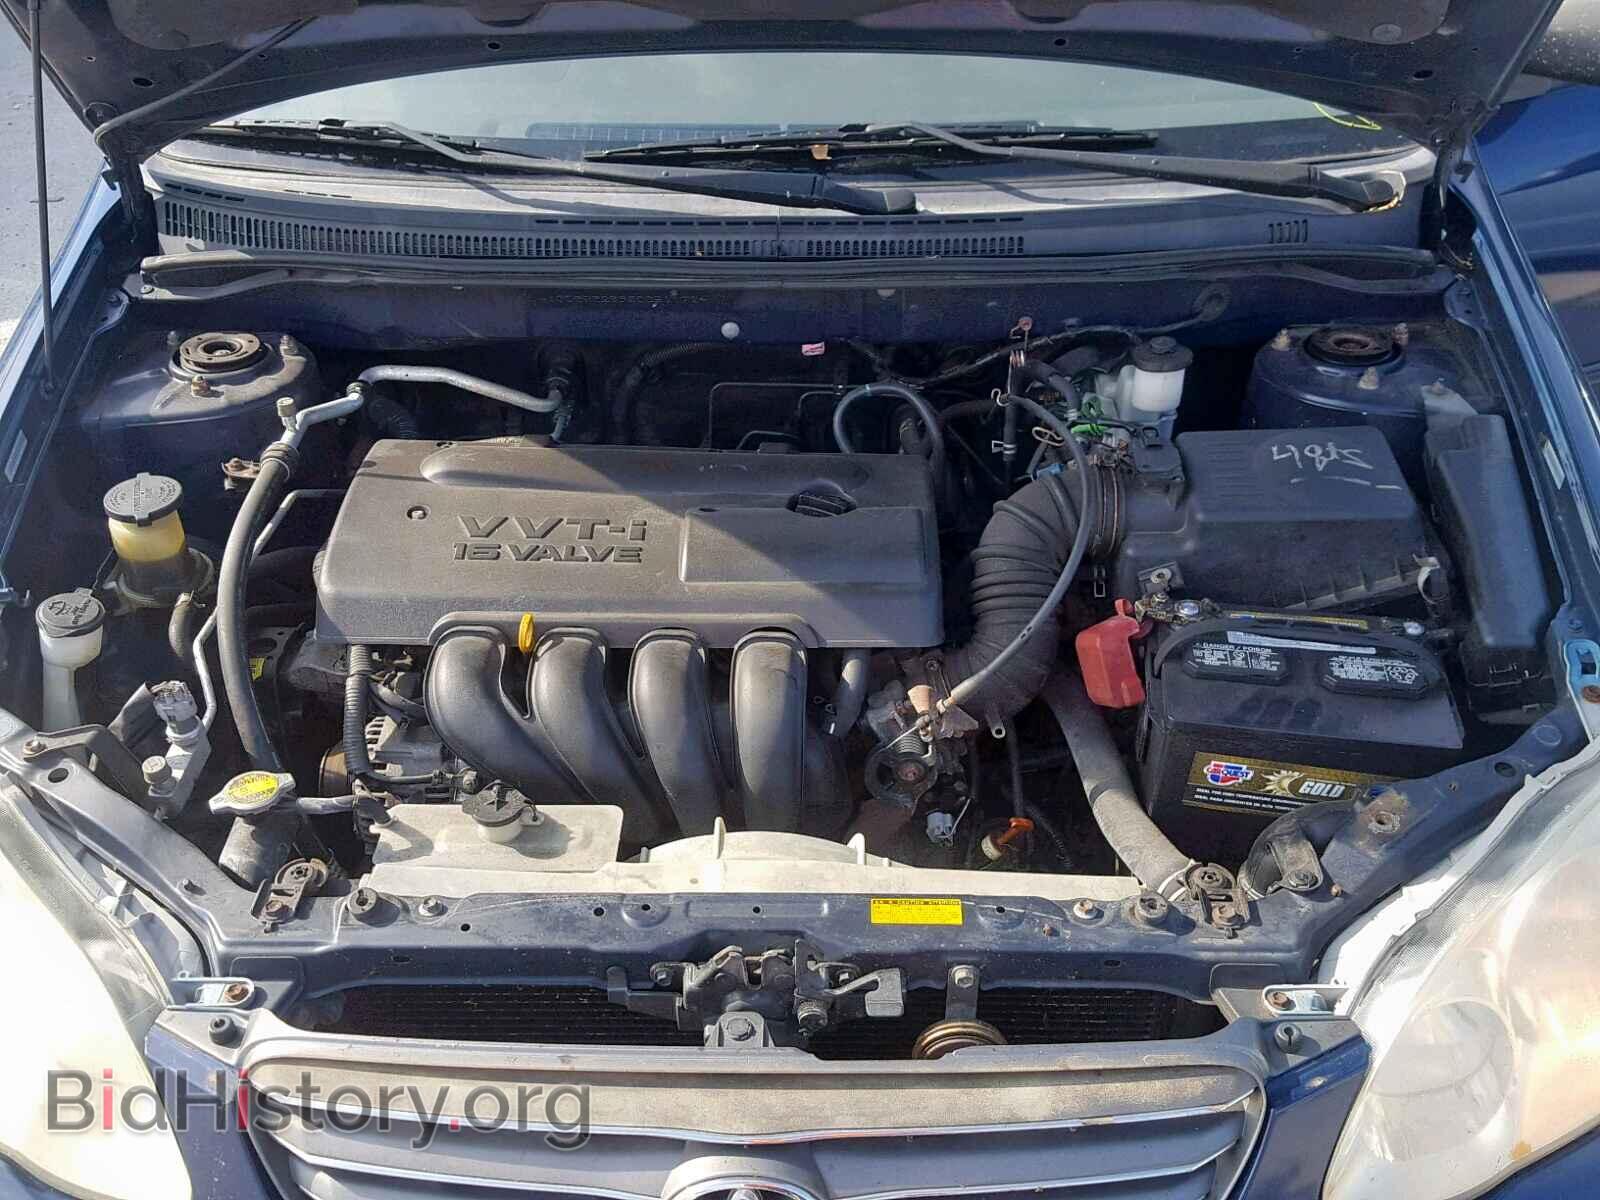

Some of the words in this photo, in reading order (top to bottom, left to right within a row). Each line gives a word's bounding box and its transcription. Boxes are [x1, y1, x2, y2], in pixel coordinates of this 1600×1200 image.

[457, 515, 647, 541] VVT-i
[453, 543, 501, 561] 16
[506, 544, 643, 563] VALVE
[1299, 781, 1345, 797] GOLD
